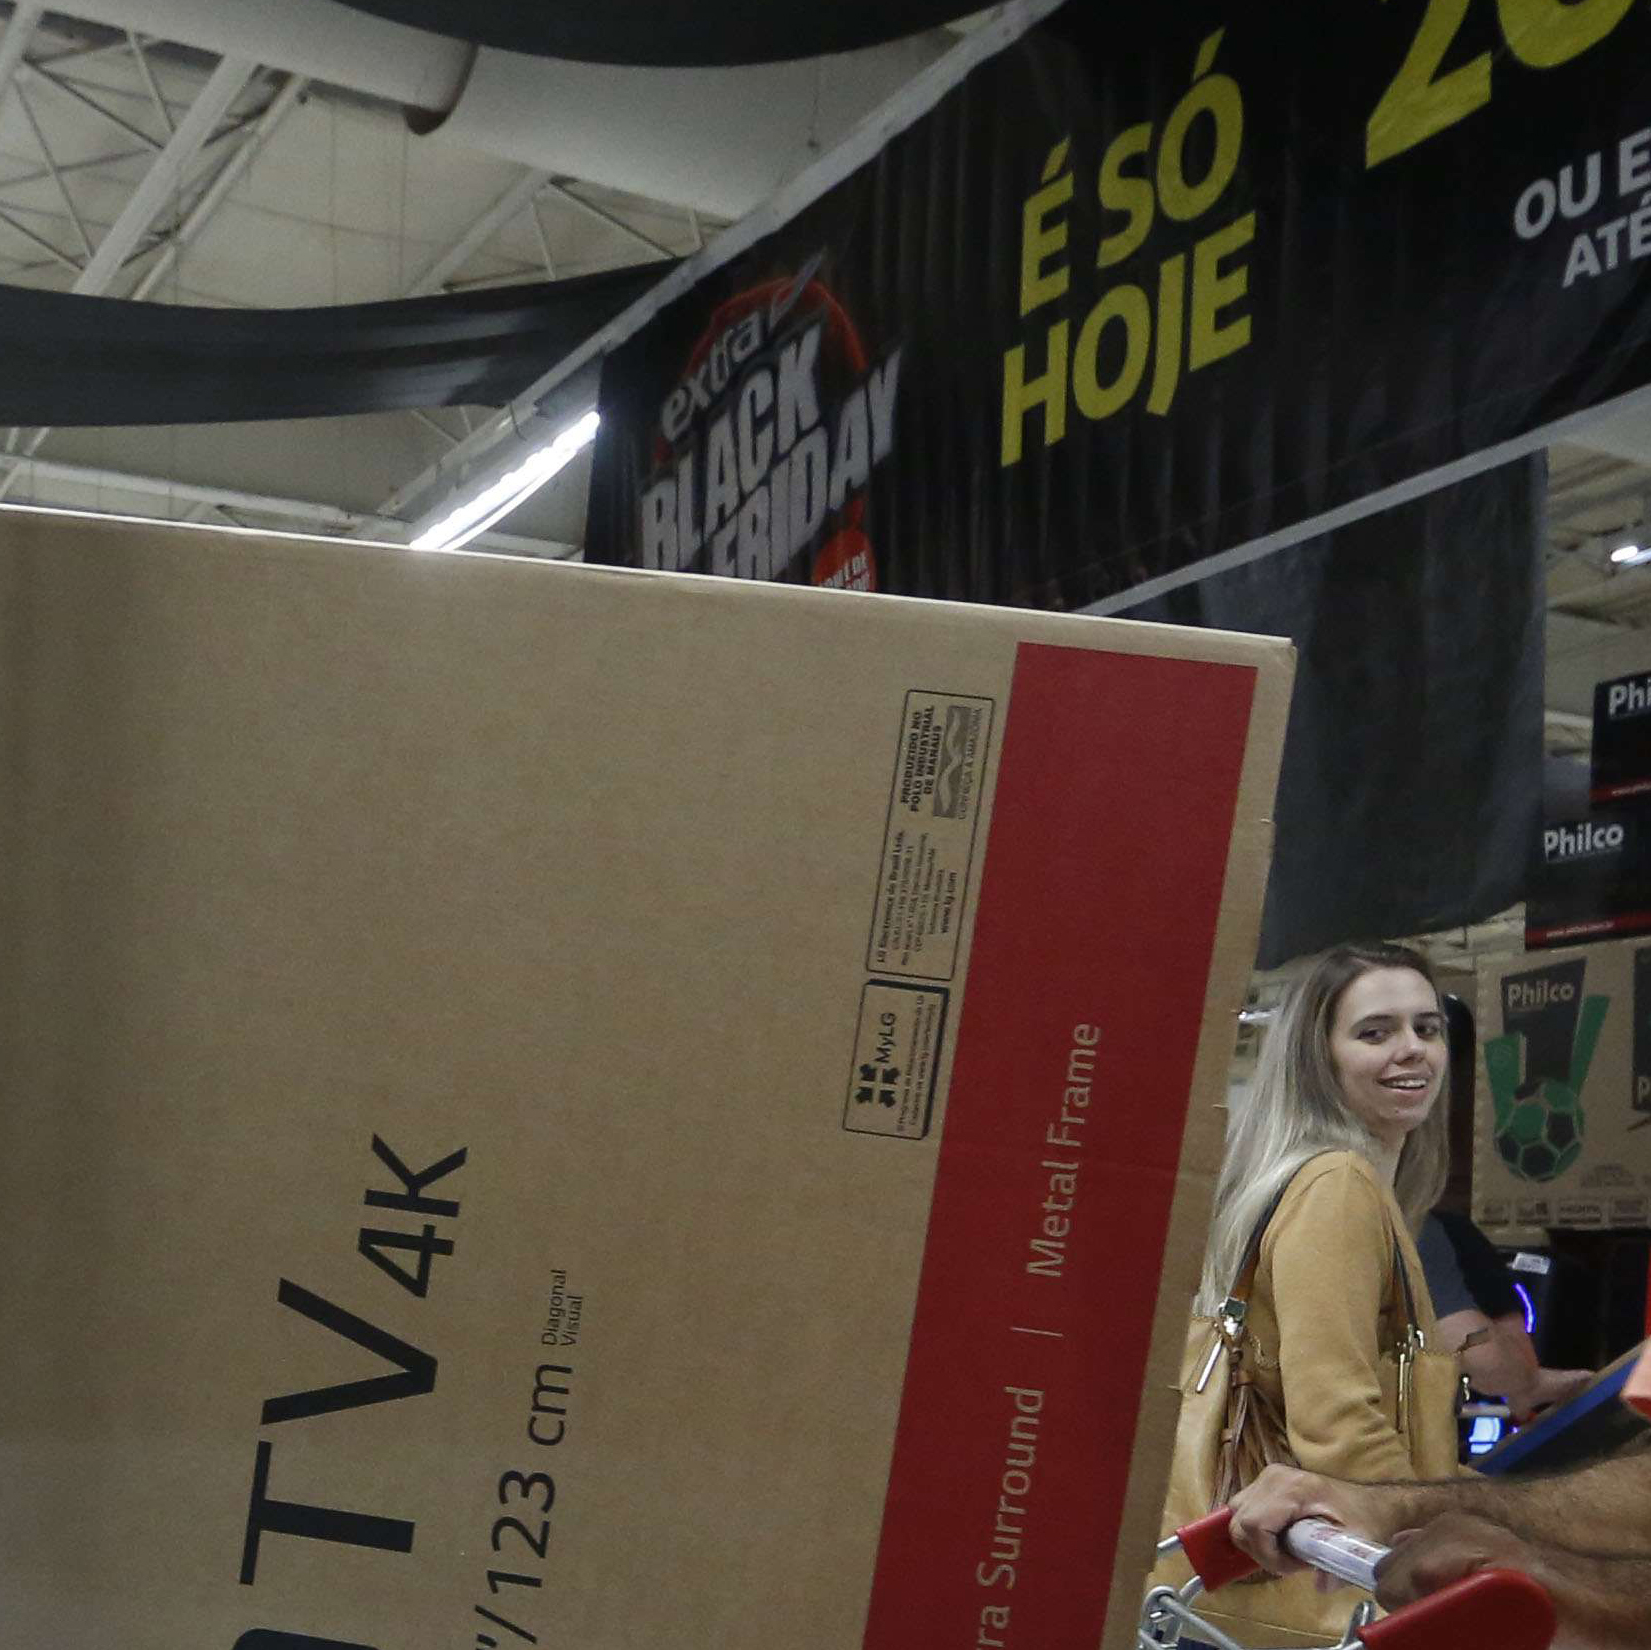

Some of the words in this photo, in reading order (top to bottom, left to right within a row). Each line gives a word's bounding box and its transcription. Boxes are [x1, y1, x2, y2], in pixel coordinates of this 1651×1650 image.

[1019, 135, 1074, 317] É
[1097, 28, 1244, 269] SÓ
[1513, 150, 1600, 240] OU
[662, 310, 761, 443] extra
[1000, 211, 1256, 467] HOJE
[642, 323, 821, 571] BLACK
[711, 349, 901, 580] FRIDAY
[1544, 823, 1624, 858] Philco
[876, 1011, 897, 1065] MyLG
[1506, 979, 1575, 1007] Philco
[1046, 1022, 1101, 1148] Frame
[1026, 1160, 1080, 1278] Metal
[541, 1268, 568, 1347] Diagonal
[558, 1294, 584, 1348] Visual
[527, 1362, 574, 1447] cm
[976, 1386, 1046, 1591] Surround
